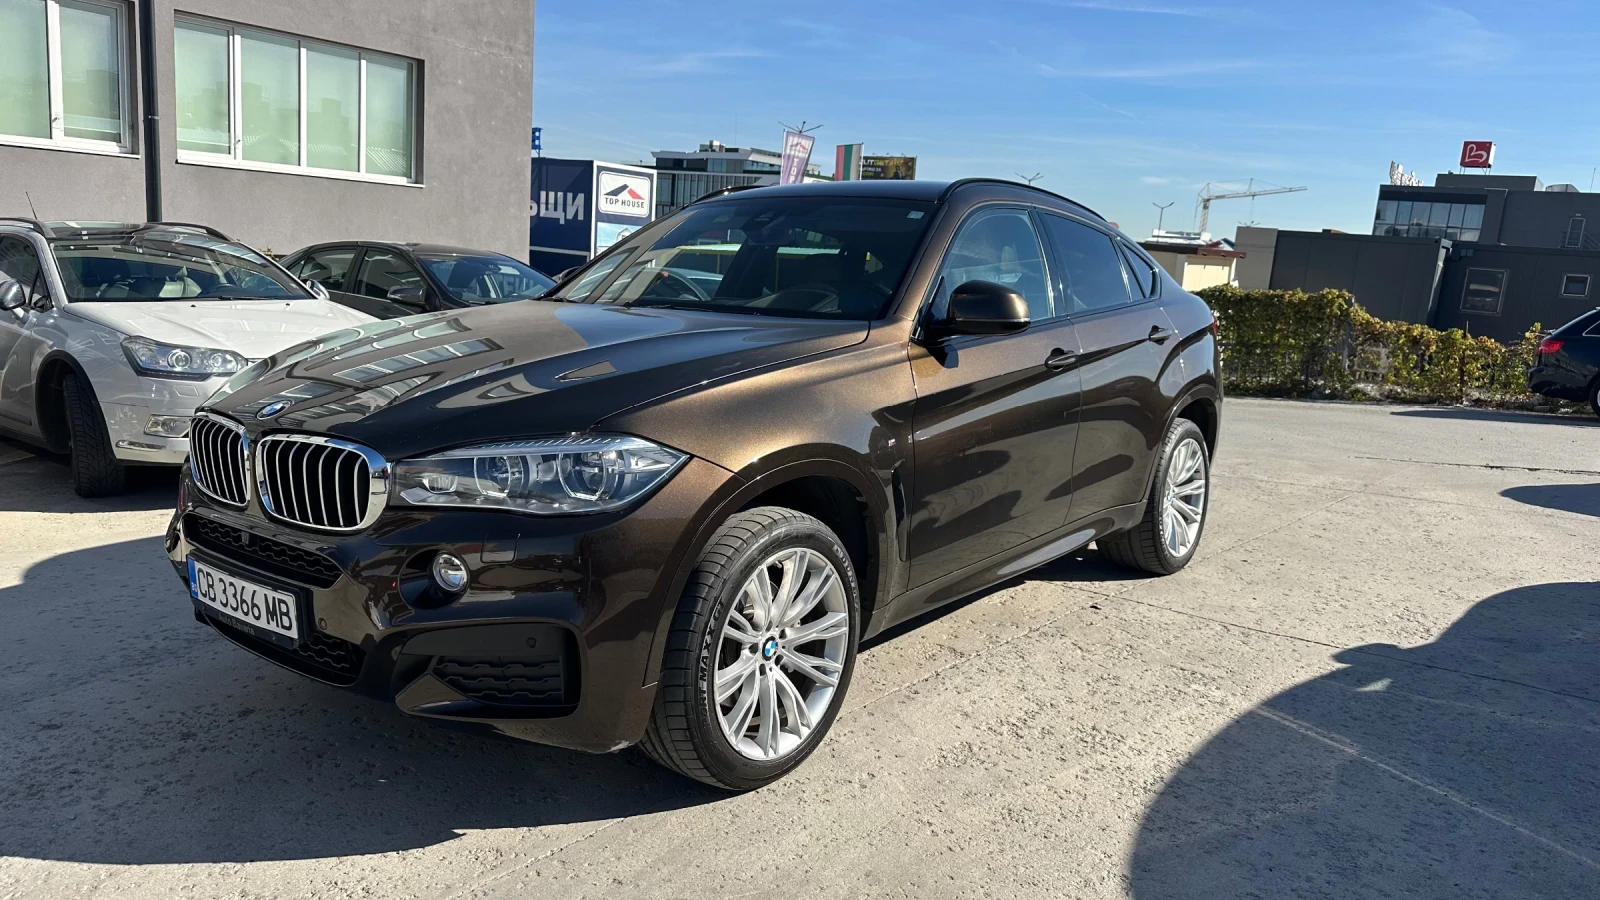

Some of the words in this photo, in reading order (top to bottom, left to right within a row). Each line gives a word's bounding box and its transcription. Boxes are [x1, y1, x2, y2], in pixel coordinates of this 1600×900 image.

[605, 197, 620, 206] TOP
[621, 199, 645, 209] HOUSE
[197, 567, 216, 602] CB
[218, 577, 261, 621] 3366
[264, 592, 292, 631] MB
